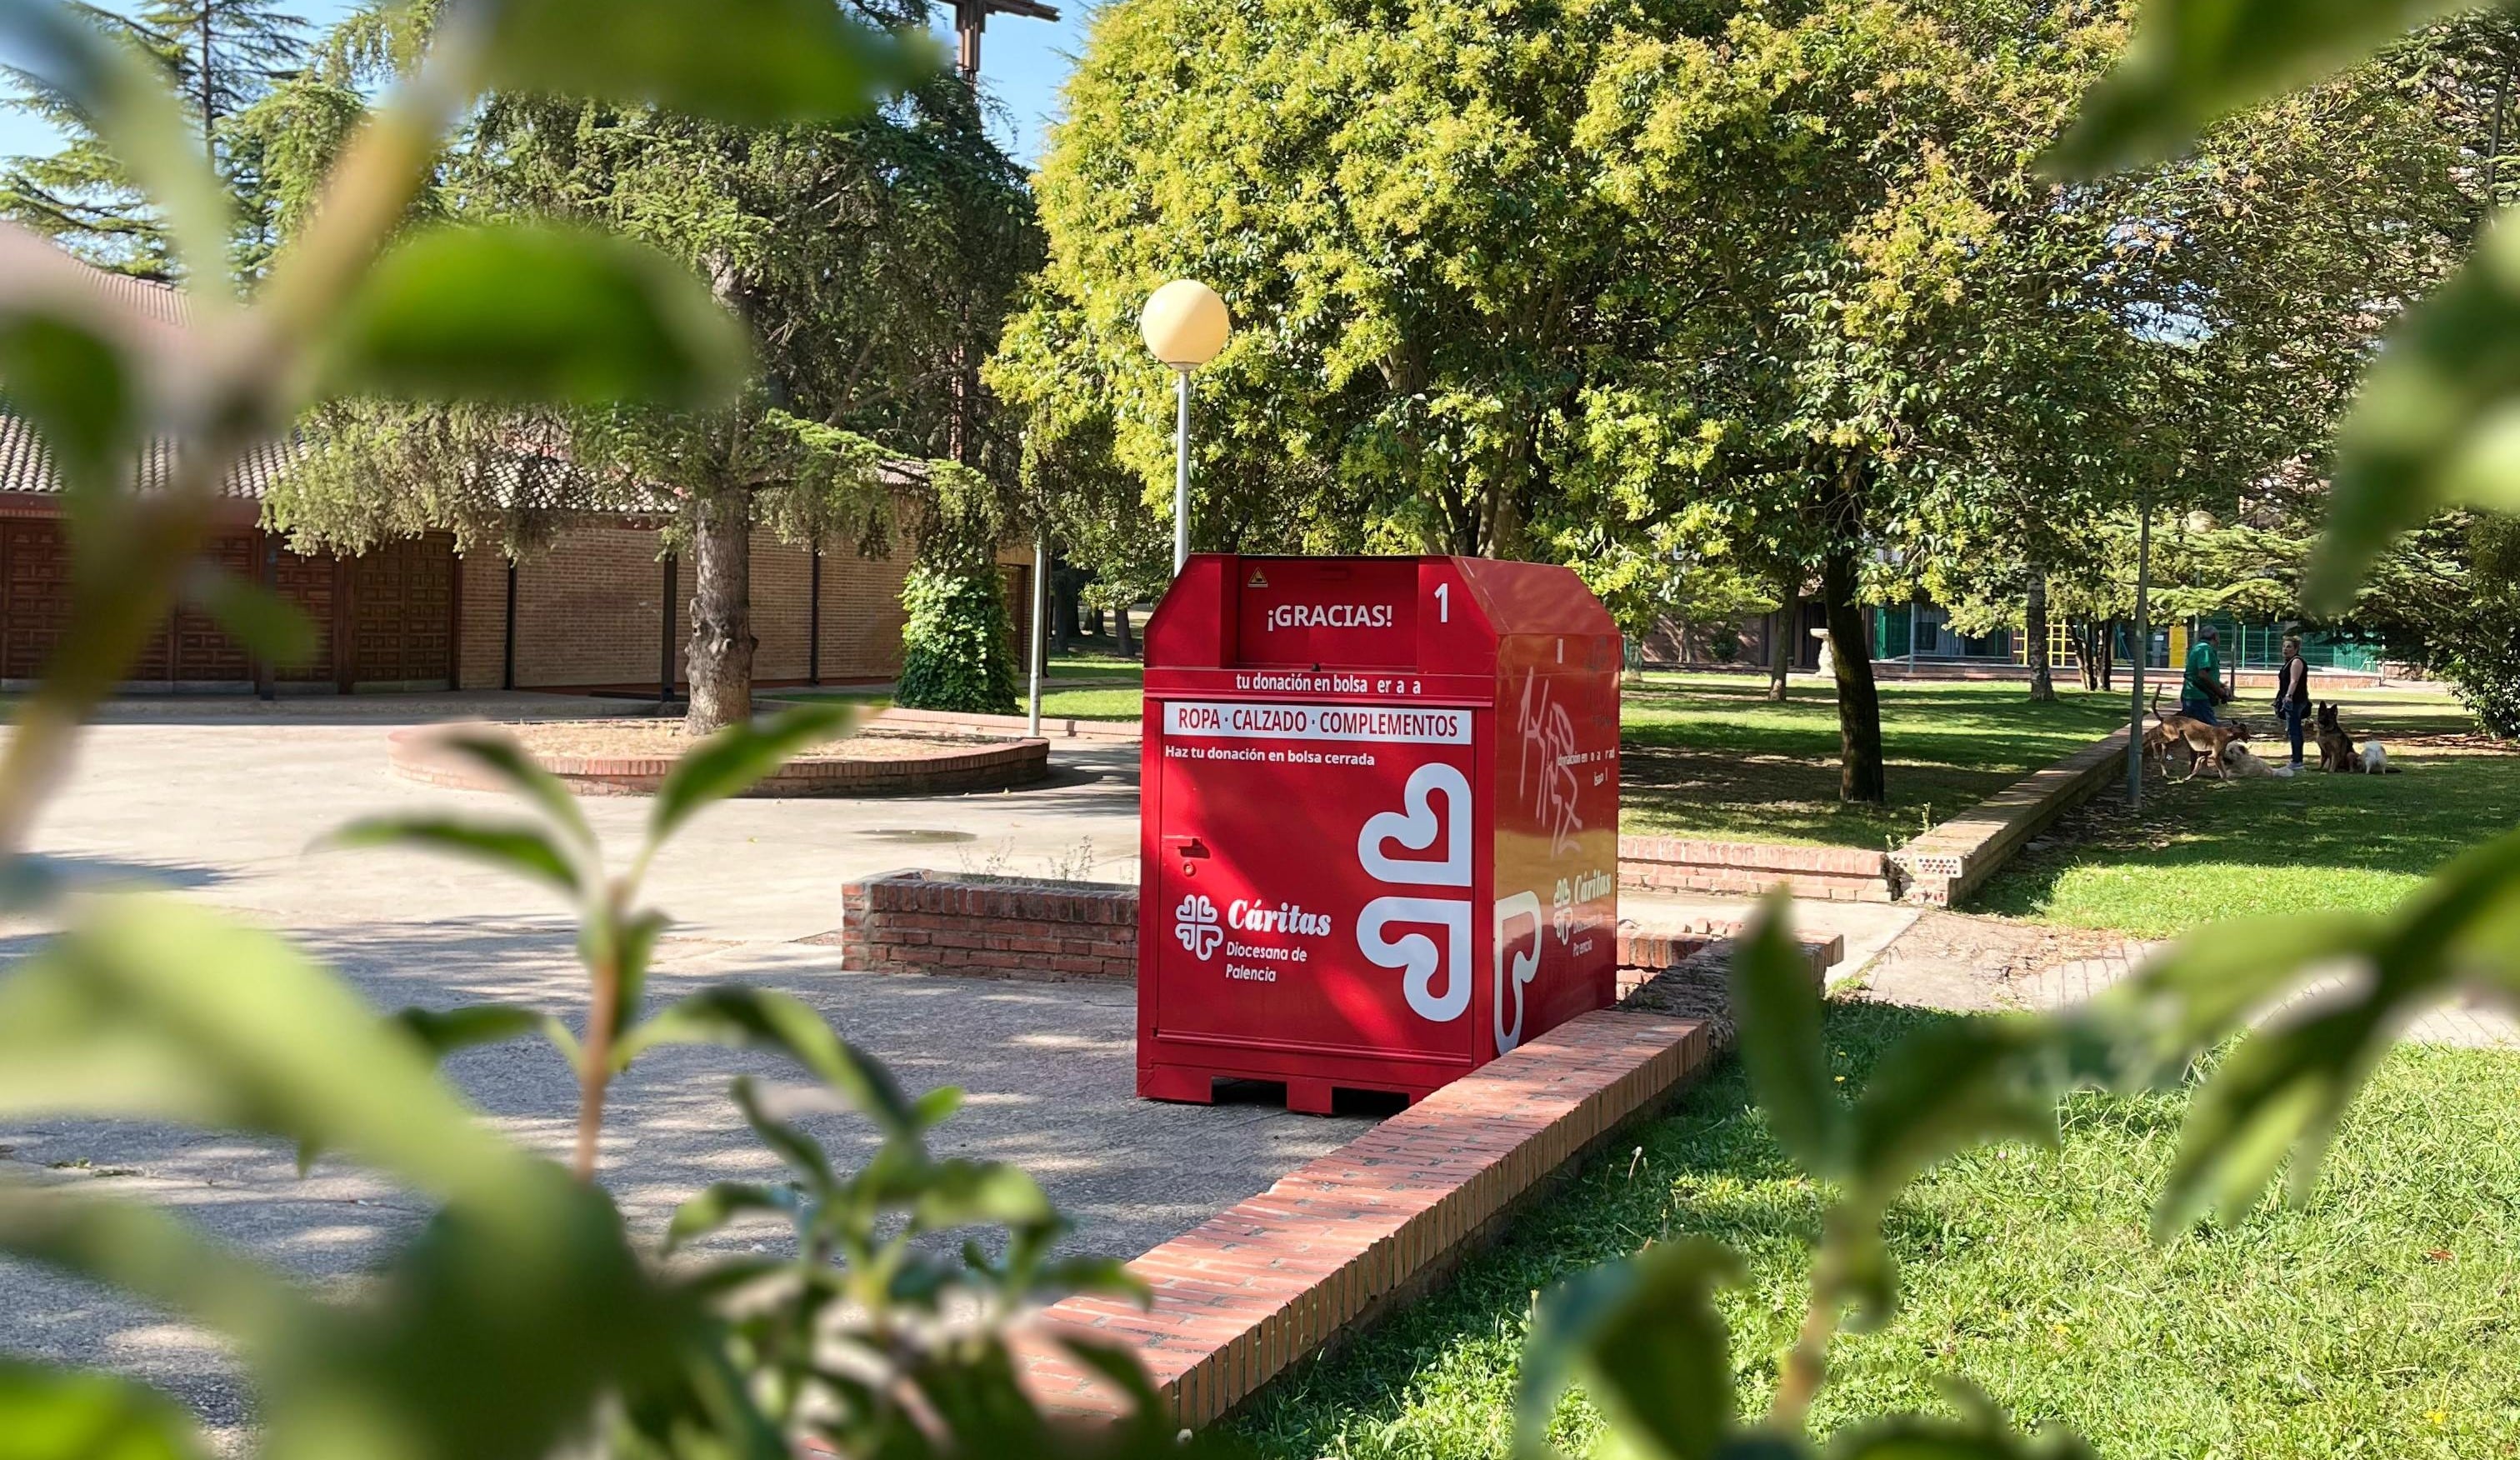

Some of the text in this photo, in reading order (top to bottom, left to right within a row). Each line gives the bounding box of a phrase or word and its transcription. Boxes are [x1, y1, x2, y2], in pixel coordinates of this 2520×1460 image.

[1434, 583, 1448, 623] 1
[1268, 604, 1392, 632] ¡GRACIAS!
[1236, 673, 1250, 690] tu
[1253, 672, 1311, 691] donación
[1314, 676, 1330, 692] en
[1333, 674, 1368, 693] bolsa
[1178, 708, 1458, 737] ROPA CALZADO COMPLEMENTOS
[1165, 745, 1375, 766] Haz tu donación en bolsa cerrada
[1574, 869, 1611, 905] Cáritas
[1228, 899, 1332, 937] Cáritas
[1227, 942, 1308, 962] Diocesana de
[1226, 963, 1277, 982] Palencia
